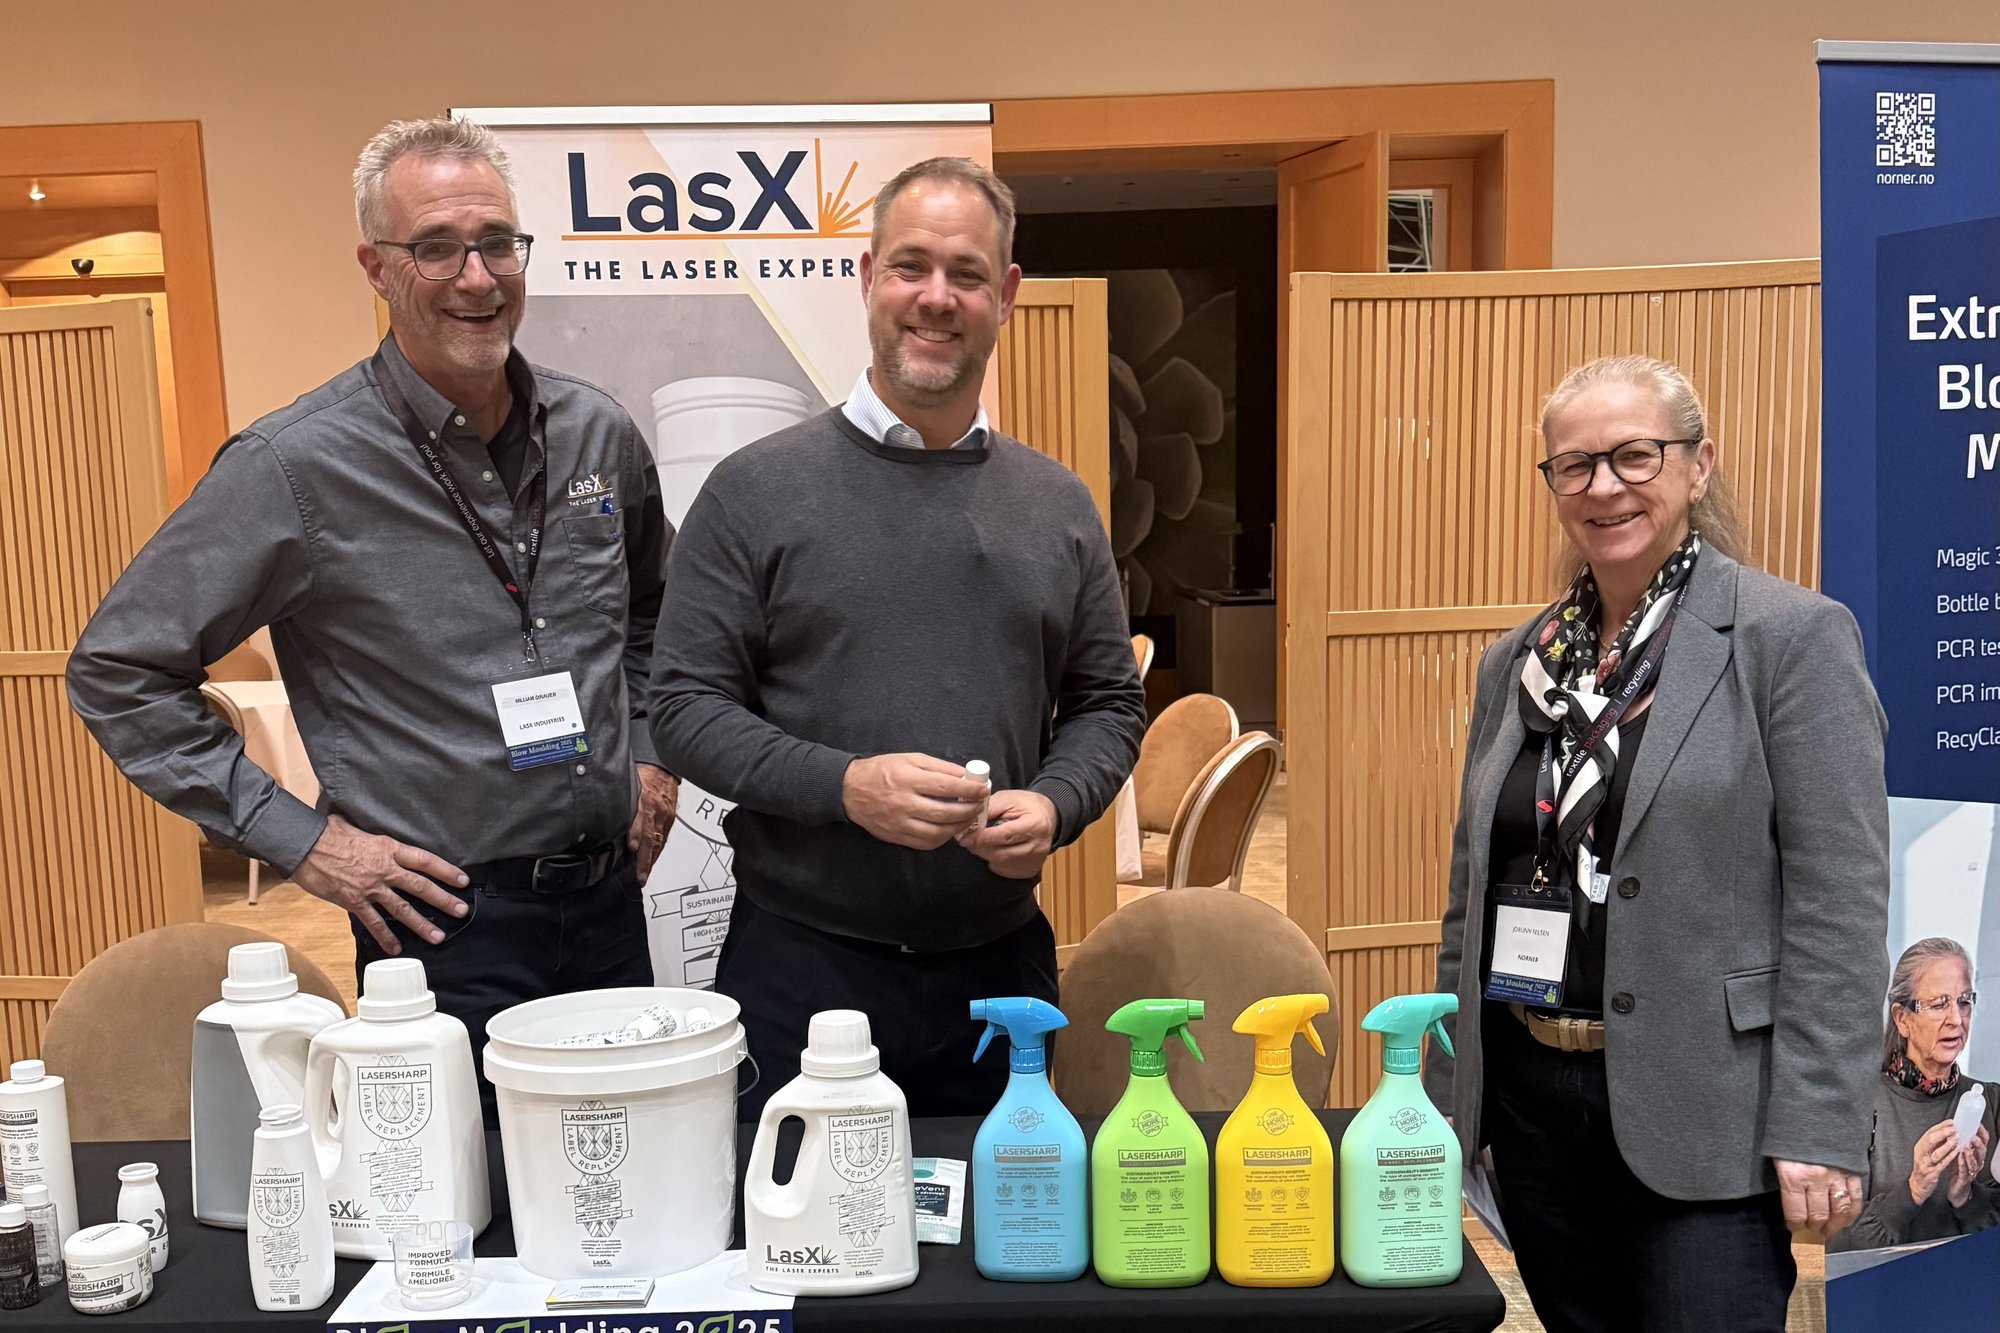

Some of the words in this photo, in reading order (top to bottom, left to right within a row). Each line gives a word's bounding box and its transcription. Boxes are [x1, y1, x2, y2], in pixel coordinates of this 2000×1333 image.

[1877, 173, 1935, 185] norner.no
[567, 150, 813, 233] LasX
[565, 261, 621, 281] THE
[642, 259, 740, 280] LASER
[1908, 294, 2000, 341] Extr
[568, 473, 603, 496] LasX
[1937, 546, 1990, 571] Magic
[1937, 592, 1989, 614] Bottle
[1937, 639, 1975, 659] PCR
[1937, 684, 1975, 704] PCR
[1566, 750, 1588, 777] textile
[1584, 707, 1618, 750] packaging
[1621, 659, 1651, 698] recycling
[511, 748, 528, 758] Blow
[528, 742, 560, 754] Moulding
[361, 1070, 428, 1080] LASERSHARP
[363, 1087, 374, 1122] LABEL
[375, 1086, 426, 1136] REPLACEMENT
[564, 1112, 624, 1122] LASERSHARP
[832, 1116, 890, 1128] LASERSHARP
[567, 1127, 577, 1158] LABEL
[578, 1126, 623, 1171] REPLACEMENT
[833, 1134, 843, 1166] LABEL
[844, 1130, 889, 1178] REPLACEMENT
[997, 1147, 1058, 1155] LASERSHARP
[1121, 1150, 1183, 1160] LASERSHARP
[1246, 1150, 1308, 1158] LASERSHARP
[1380, 1148, 1442, 1158] LASERSHARP
[254, 1177, 300, 1185] LASERSHARP
[408, 1250, 452, 1259] IMPROVED
[410, 1257, 450, 1266] FORMULA
[766, 1244, 821, 1264] LasX
[411, 1268, 450, 1278] FORMULE
